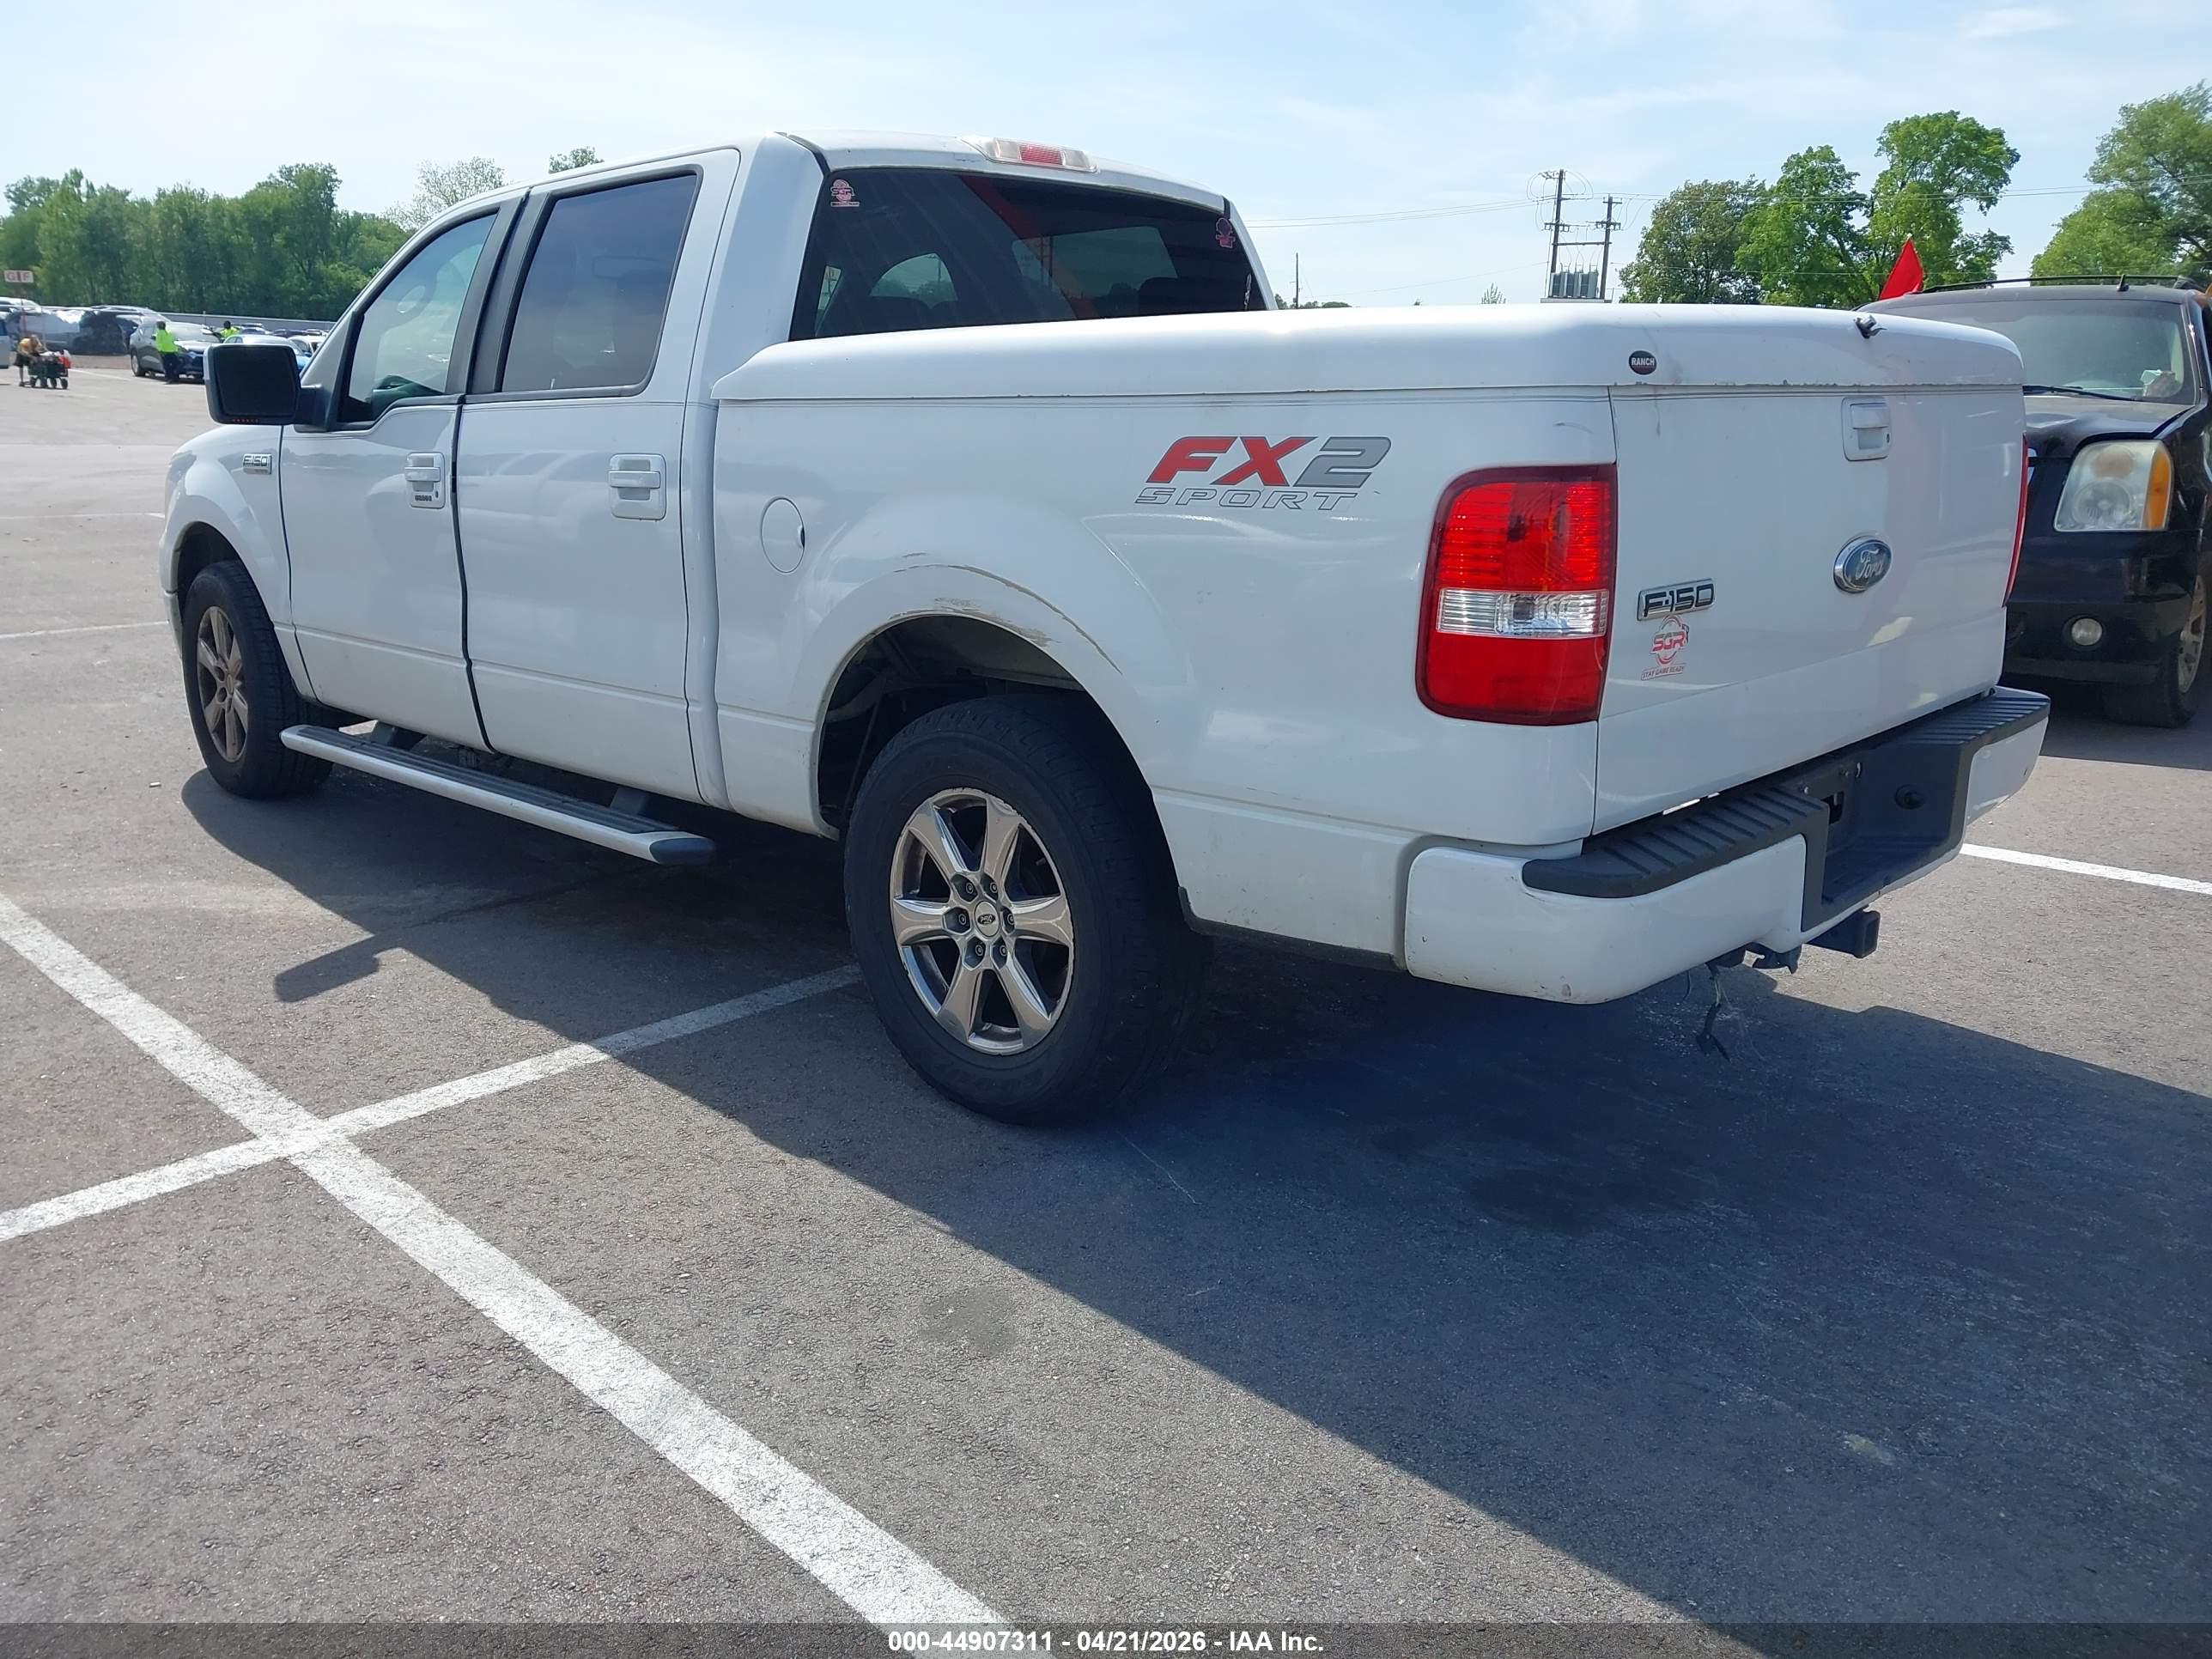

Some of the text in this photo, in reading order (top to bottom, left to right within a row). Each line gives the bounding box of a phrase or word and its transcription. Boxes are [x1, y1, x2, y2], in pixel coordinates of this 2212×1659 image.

[1632, 357, 1655, 366] RANCH
[1146, 436, 1392, 488] FX2
[1134, 488, 1358, 511] SPORT
